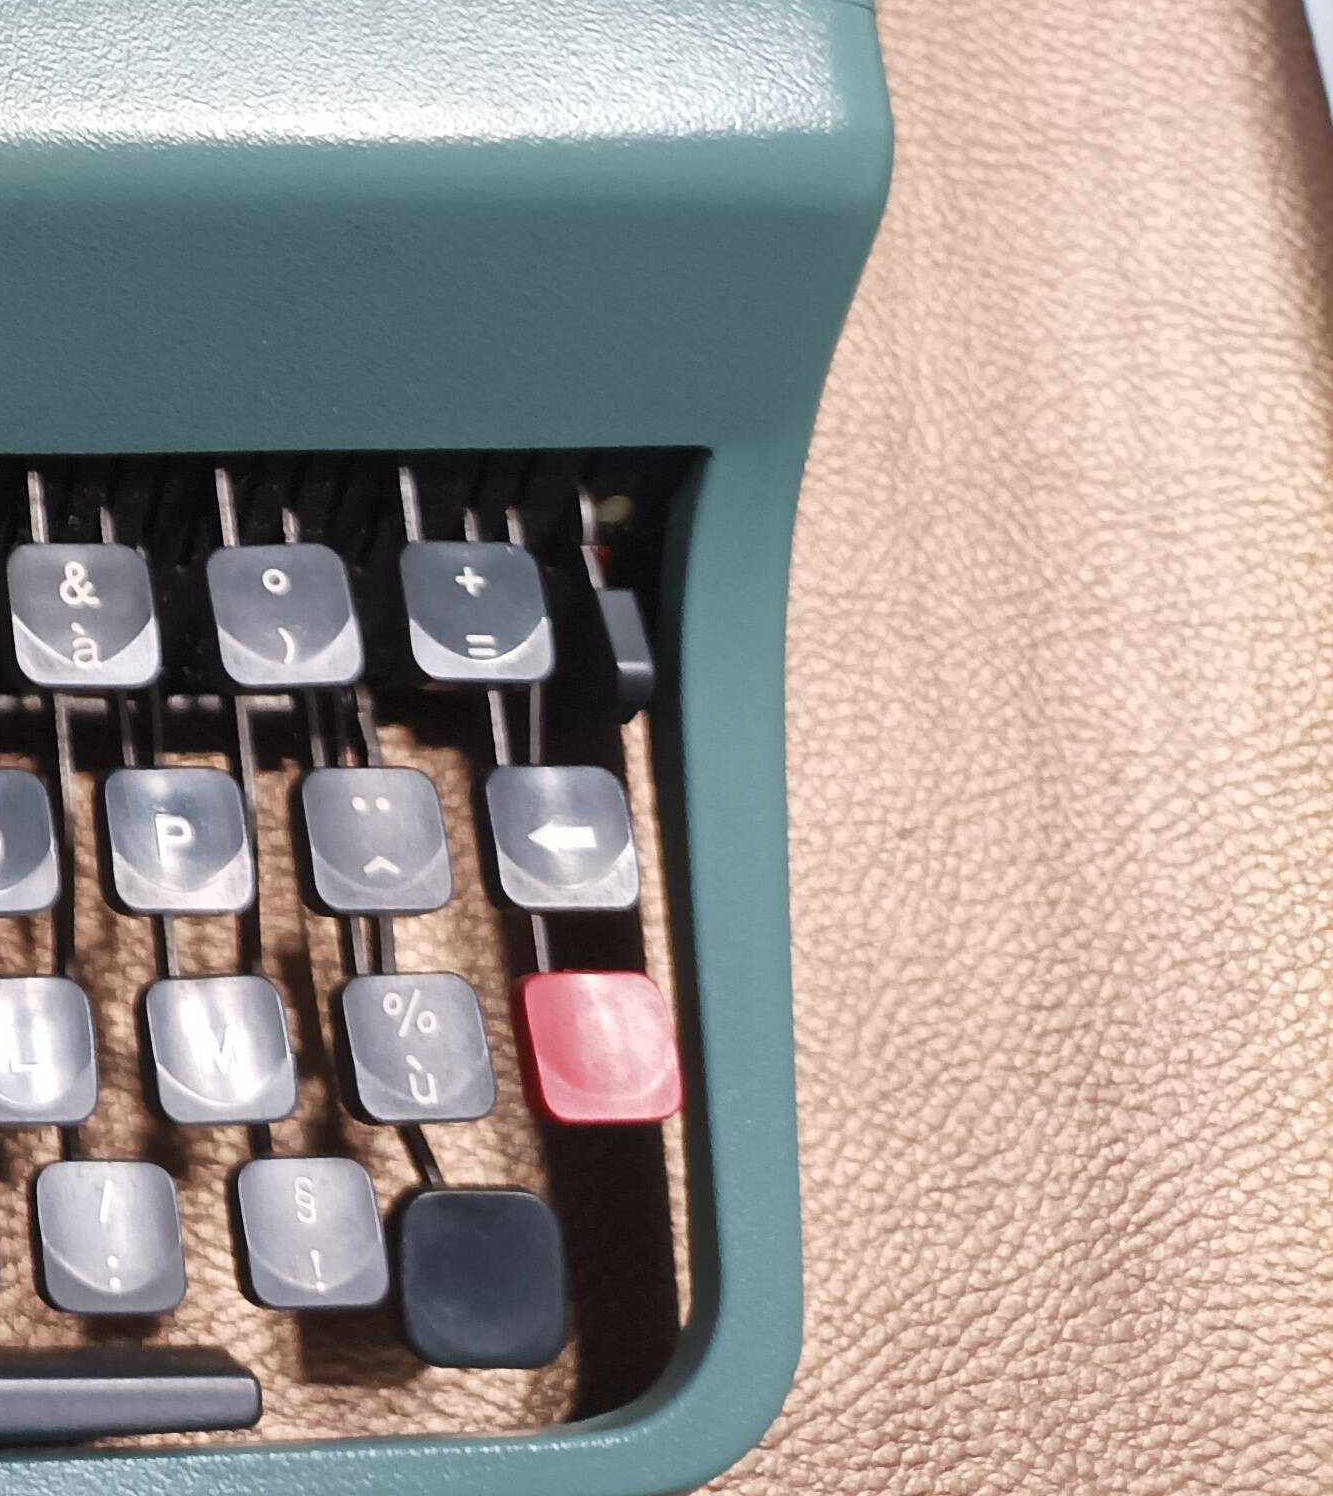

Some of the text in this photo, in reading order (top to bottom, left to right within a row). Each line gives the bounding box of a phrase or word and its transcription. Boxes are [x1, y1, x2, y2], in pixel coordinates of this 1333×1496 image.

[59, 560, 101, 606] &
[454, 565, 486, 594] +
[70, 622, 103, 668] à
[276, 626, 297, 664] )
[465, 634, 497, 656] =
[154, 813, 194, 866] P
[382, 988, 437, 1038] %
[9, 1024, 44, 1072] L
[405, 1055, 439, 1104] ù
[293, 1176, 317, 1224] §
[106, 1254, 121, 1291] :
[310, 1249, 326, 1293] !
